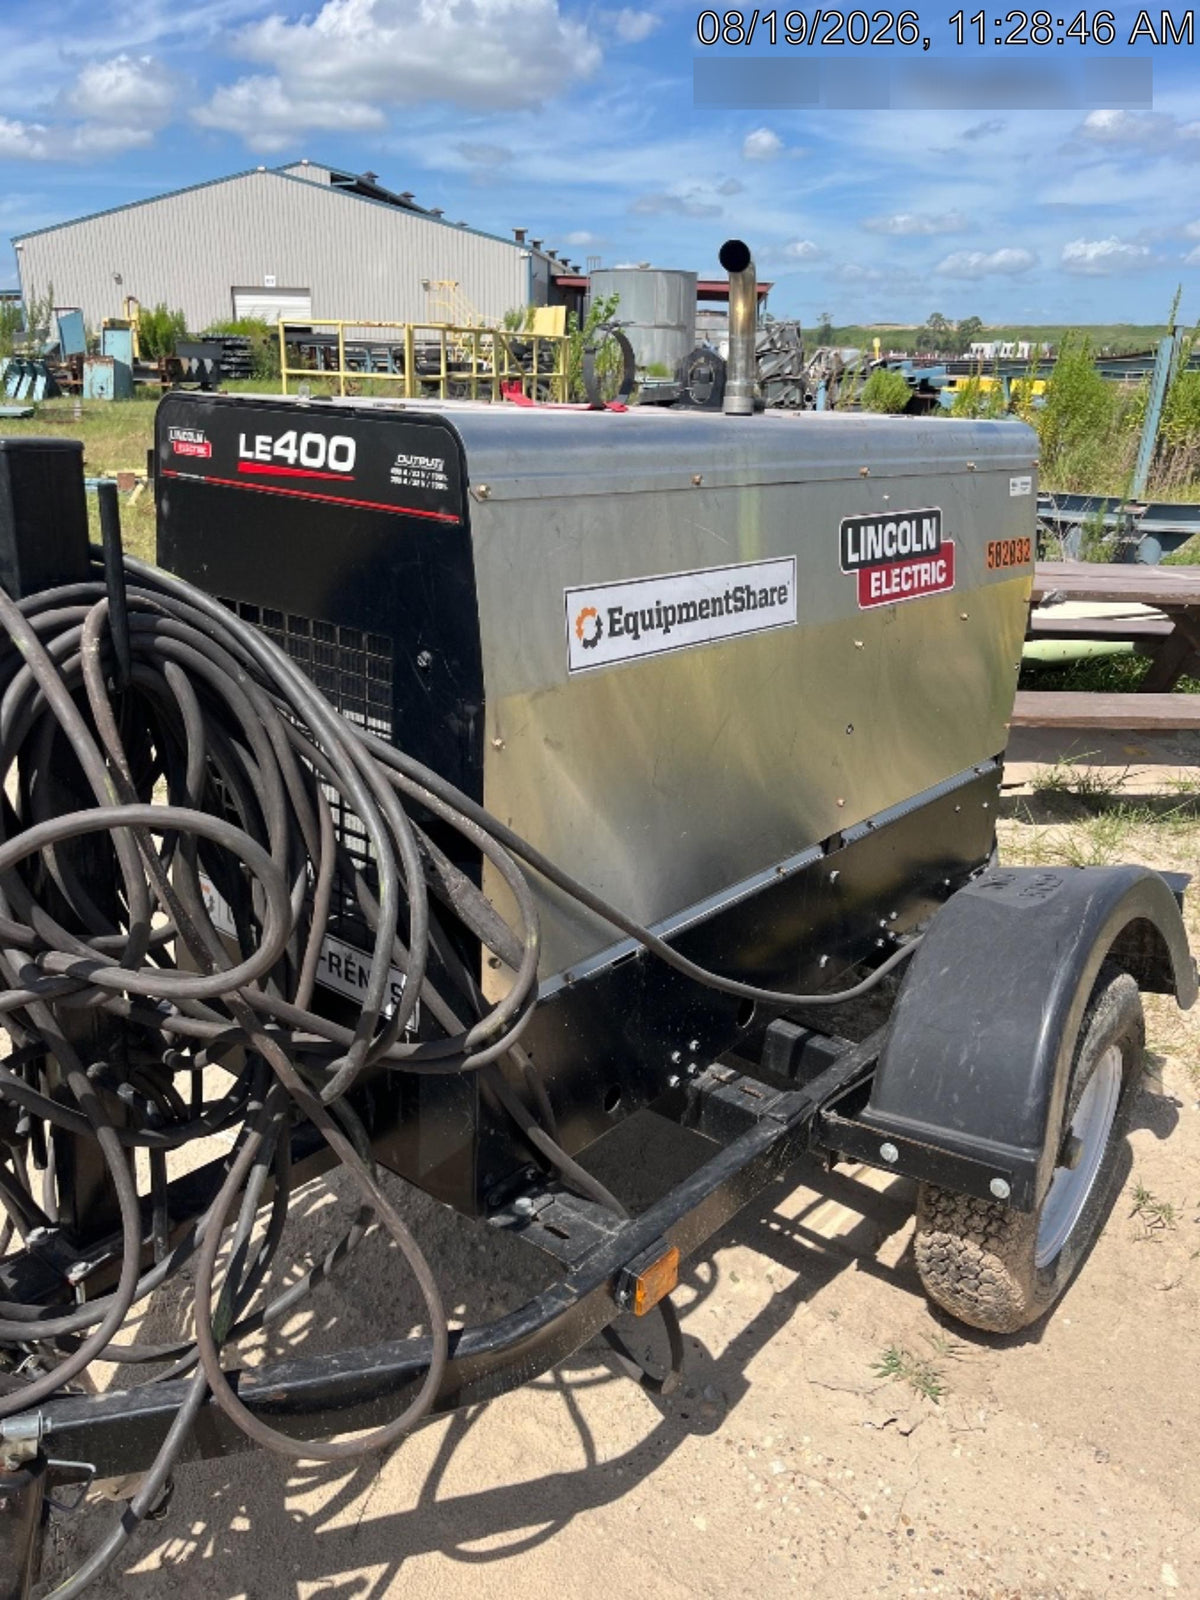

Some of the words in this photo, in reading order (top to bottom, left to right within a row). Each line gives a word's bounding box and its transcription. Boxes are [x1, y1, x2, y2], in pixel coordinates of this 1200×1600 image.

[169, 429, 204, 443] LINCOLN
[239, 430, 356, 472] LE400
[847, 516, 938, 564] LINCOLN
[870, 559, 947, 599] ELECTRIC
[607, 582, 789, 641] EquipmentShare
